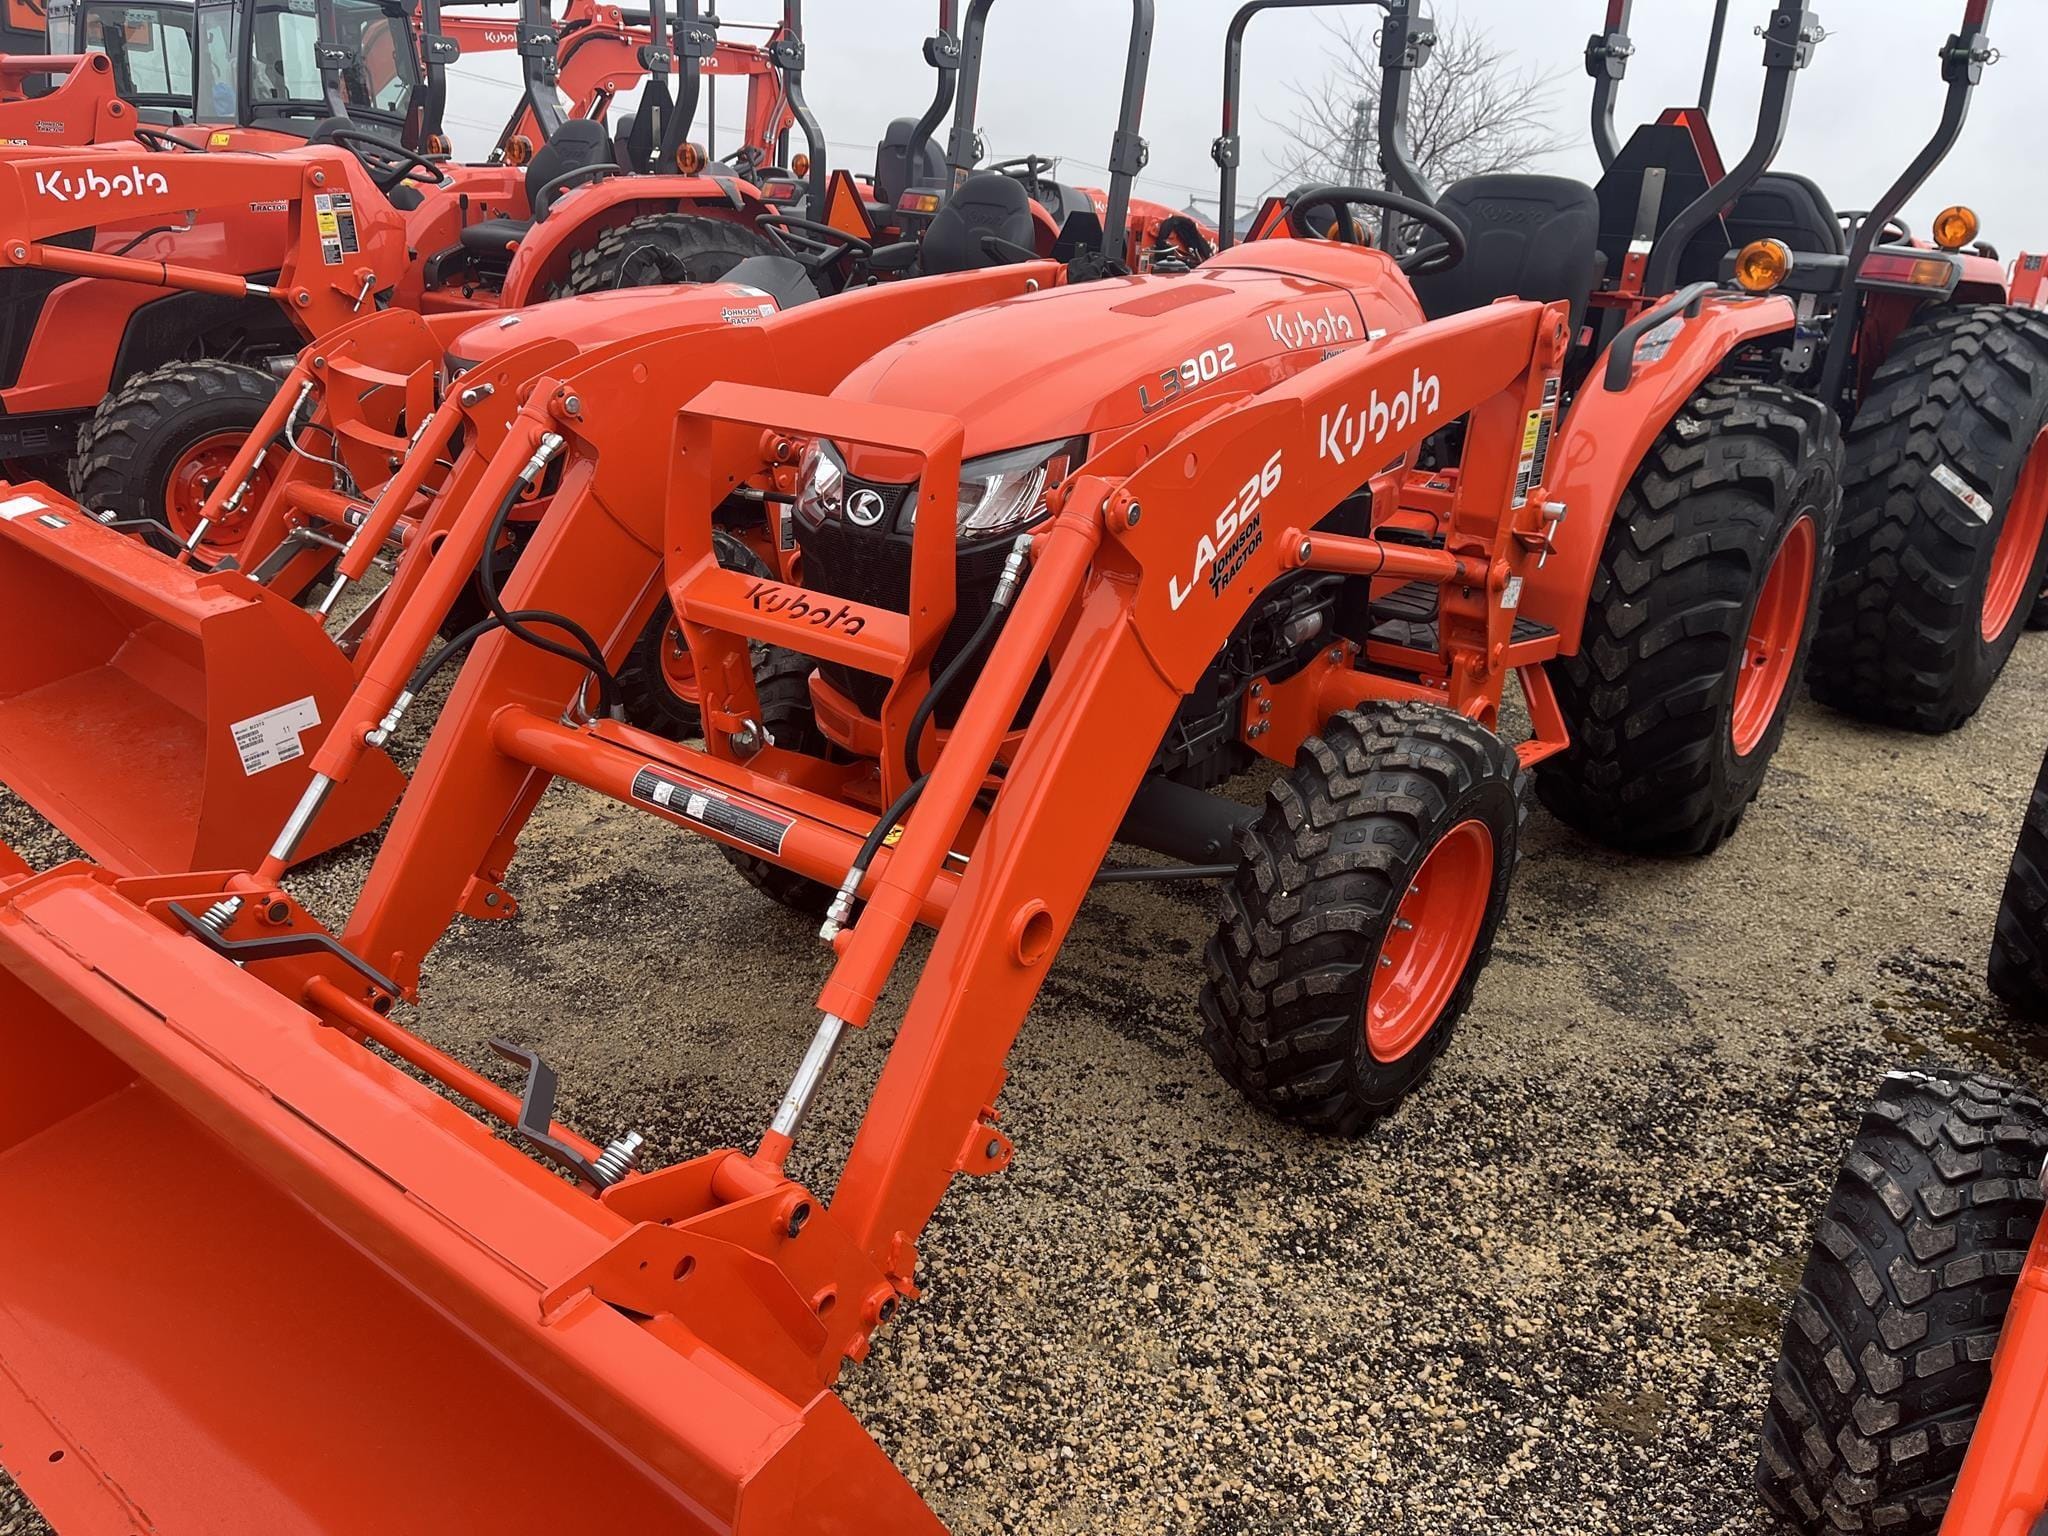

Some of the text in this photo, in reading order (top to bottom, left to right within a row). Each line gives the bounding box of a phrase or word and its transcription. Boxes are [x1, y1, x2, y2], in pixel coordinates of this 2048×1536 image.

[35, 165, 169, 201] Kubota
[250, 203, 287, 212] TRACTOR
[721, 308, 758, 317] JOHNSON
[1265, 307, 1355, 349] Kubota
[1139, 342, 1238, 413] L3902
[1320, 367, 1440, 465] Kubota
[1169, 449, 1282, 611] LA526
[1209, 513, 1260, 584] JOHNSON
[1211, 530, 1263, 599] TRACTOR
[744, 583, 866, 636] Kubota
